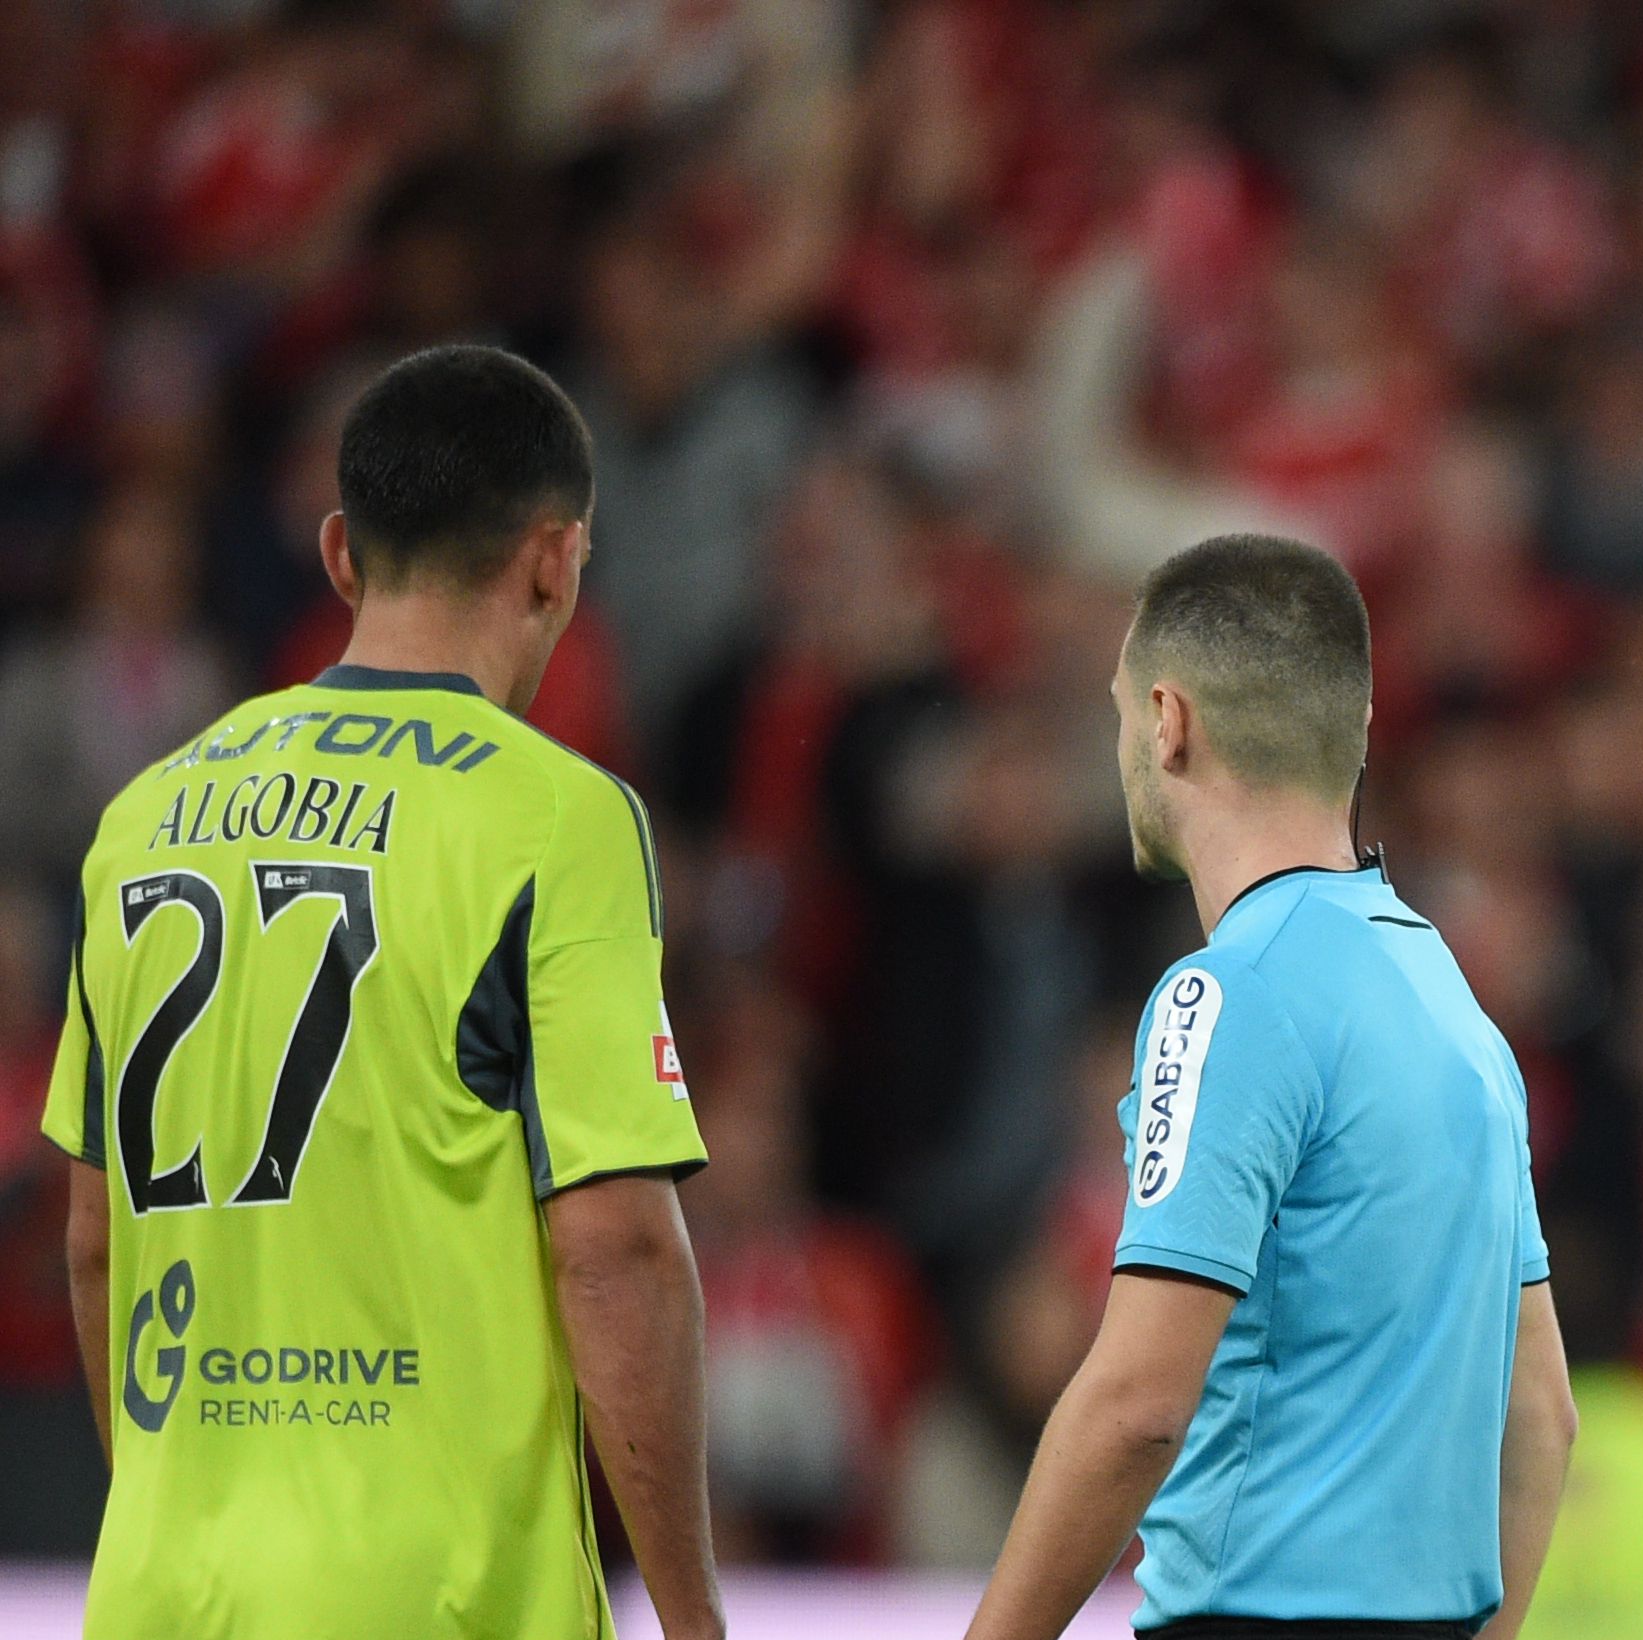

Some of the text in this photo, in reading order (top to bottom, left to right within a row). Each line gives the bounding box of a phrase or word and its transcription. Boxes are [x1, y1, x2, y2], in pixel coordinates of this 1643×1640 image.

[147, 773, 396, 855] ALGOBIA
[116, 860, 380, 1217] 27
[1145, 975, 1206, 1146] SABSEG
[200, 1348, 420, 1386] GODRIVE
[201, 1399, 391, 1426] RENT-A-CAR
